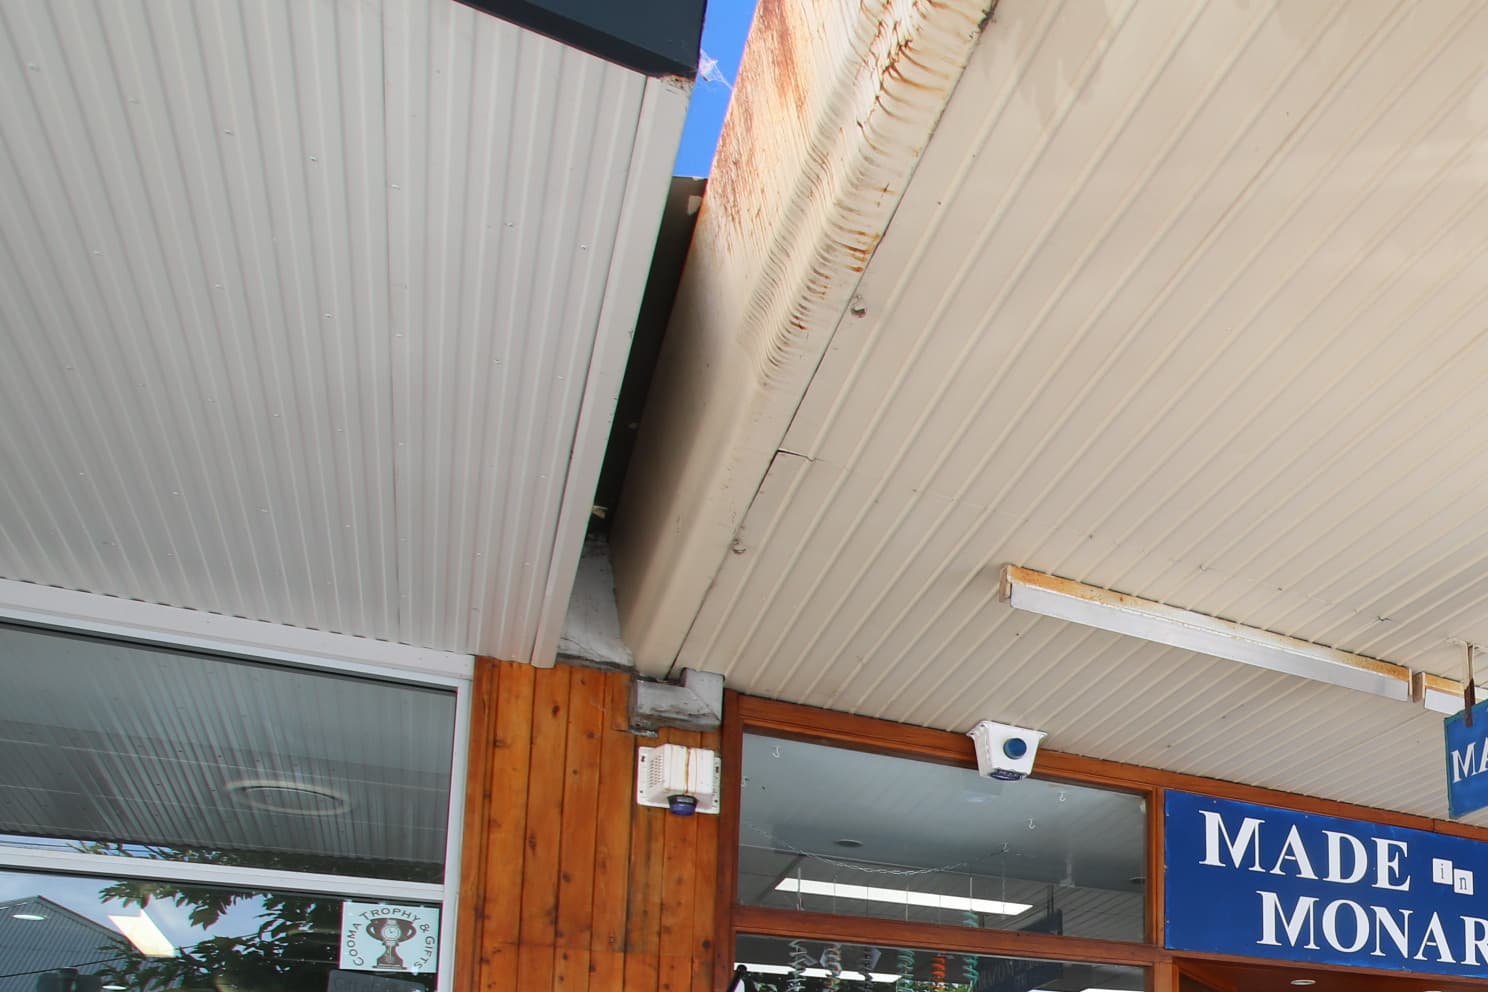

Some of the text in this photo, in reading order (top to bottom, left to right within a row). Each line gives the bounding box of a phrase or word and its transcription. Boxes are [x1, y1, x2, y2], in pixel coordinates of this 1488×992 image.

[1199, 810, 1411, 892] MADE
[1436, 860, 1471, 893] in
[347, 907, 435, 968] COOMA TROPHY & GIFTS
